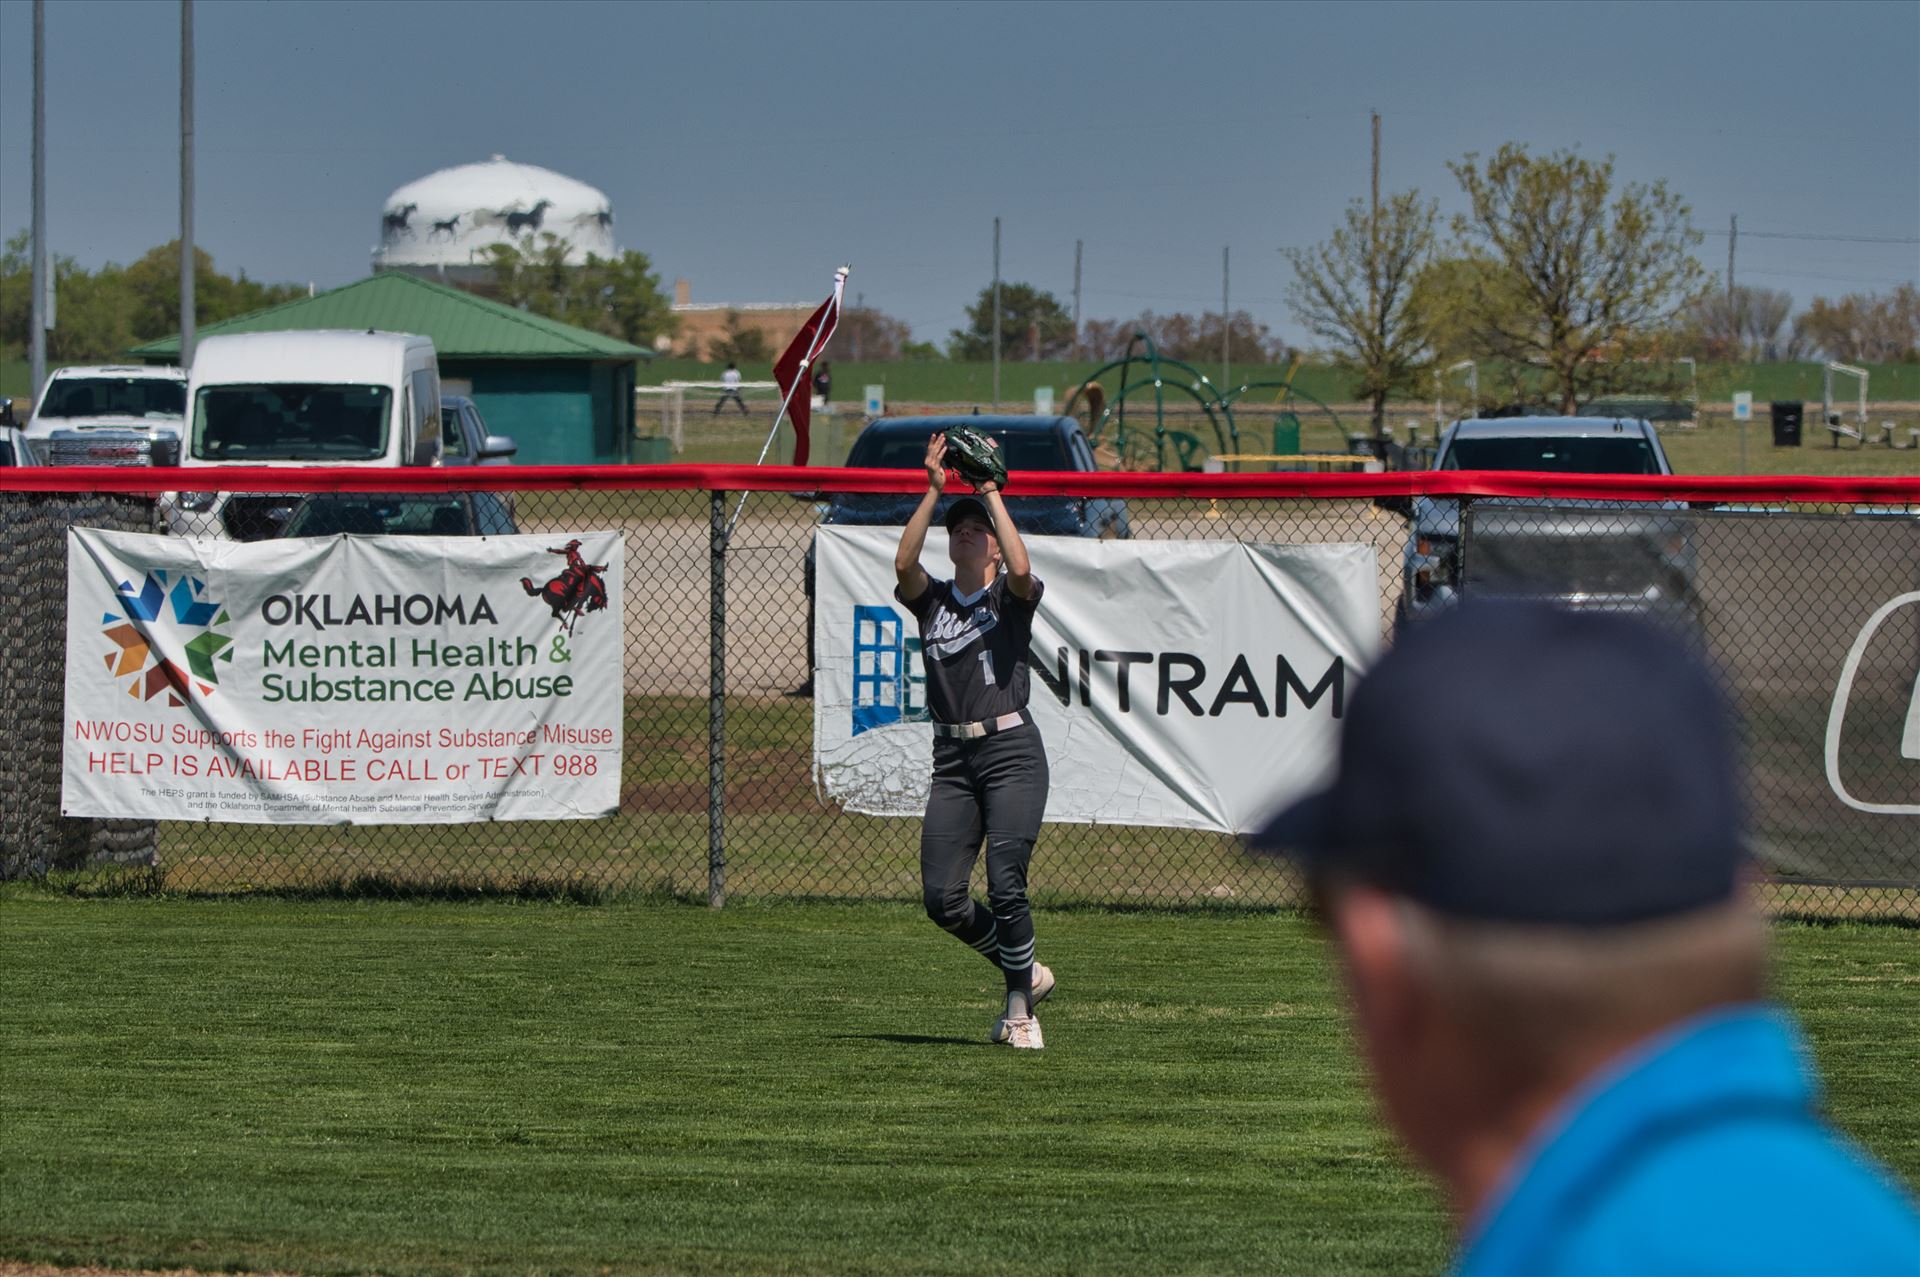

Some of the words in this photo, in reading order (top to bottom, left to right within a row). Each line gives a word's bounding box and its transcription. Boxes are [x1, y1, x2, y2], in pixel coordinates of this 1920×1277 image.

[261, 594, 498, 631] OKLAHOMA
[263, 637, 396, 667] Mental
[412, 637, 537, 667] Health
[549, 634, 571, 663] &
[978, 649, 996, 685] 1
[262, 673, 455, 702] Substance
[464, 671, 573, 701] Abuse
[75, 720, 164, 744] NWOSU
[172, 723, 257, 750] Supports
[264, 729, 295, 748] the
[303, 728, 352, 754] Fight
[356, 728, 431, 753] Against
[438, 727, 537, 749] Substance
[543, 724, 613, 744] Misuse
[89, 752, 163, 775] HELP
[174, 755, 198, 777] IS
[207, 755, 356, 782] AVAILABLE
[366, 759, 438, 781] CALL
[446, 764, 470, 780] or
[478, 755, 545, 779] TEXT
[553, 754, 598, 776] 988
[140, 788, 156, 797] The
[159, 789, 184, 797] HEPS
[187, 791, 208, 800] grant
[218, 791, 246, 800] funded
[249, 792, 258, 801] by
[260, 793, 299, 801] SAMHSA
[349, 794, 375, 802] Abuse
[377, 794, 393, 802] and
[395, 793, 422, 801] Mental
[424, 793, 450, 802] Health
[187, 801, 203, 809] and
[205, 801, 218, 809] the
[220, 801, 262, 810] Oklahoma
[263, 802, 310, 812] Department
[322, 803, 350, 812] Mental
[352, 803, 376, 812] health
[379, 804, 421, 812] Substance
[424, 803, 466, 812] Prevention
